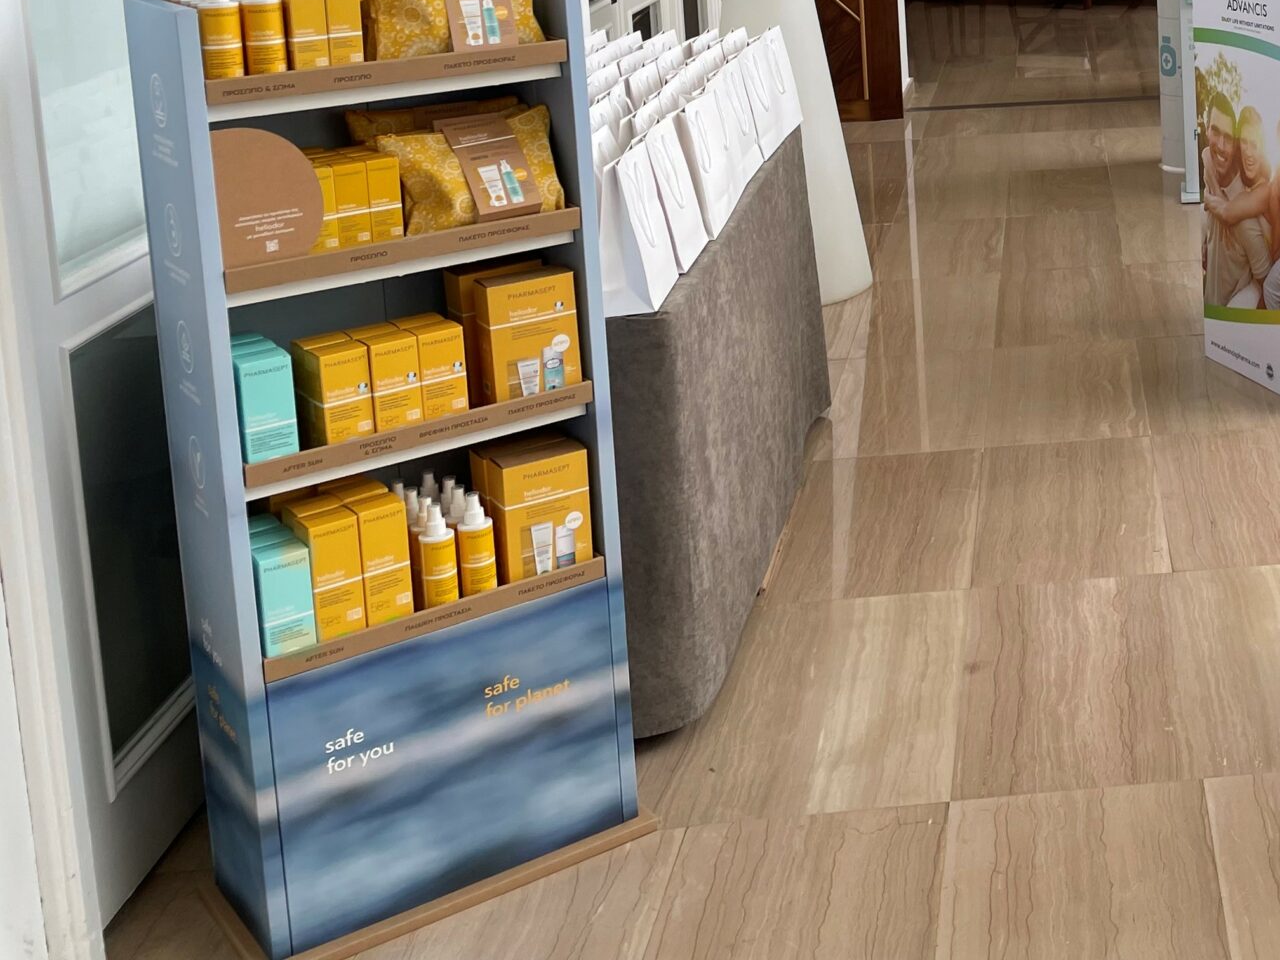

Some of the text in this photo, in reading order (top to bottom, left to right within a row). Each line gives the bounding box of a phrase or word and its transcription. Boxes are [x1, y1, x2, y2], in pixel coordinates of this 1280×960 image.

[508, 285, 556, 300] PHARMASEPT
[283, 458, 323, 473] AFTER SUN
[523, 464, 570, 480] PHARMASEPT
[484, 674, 520, 699] safe
[484, 678, 571, 720] for planet
[325, 728, 365, 753] safe
[326, 741, 394, 775] for you
